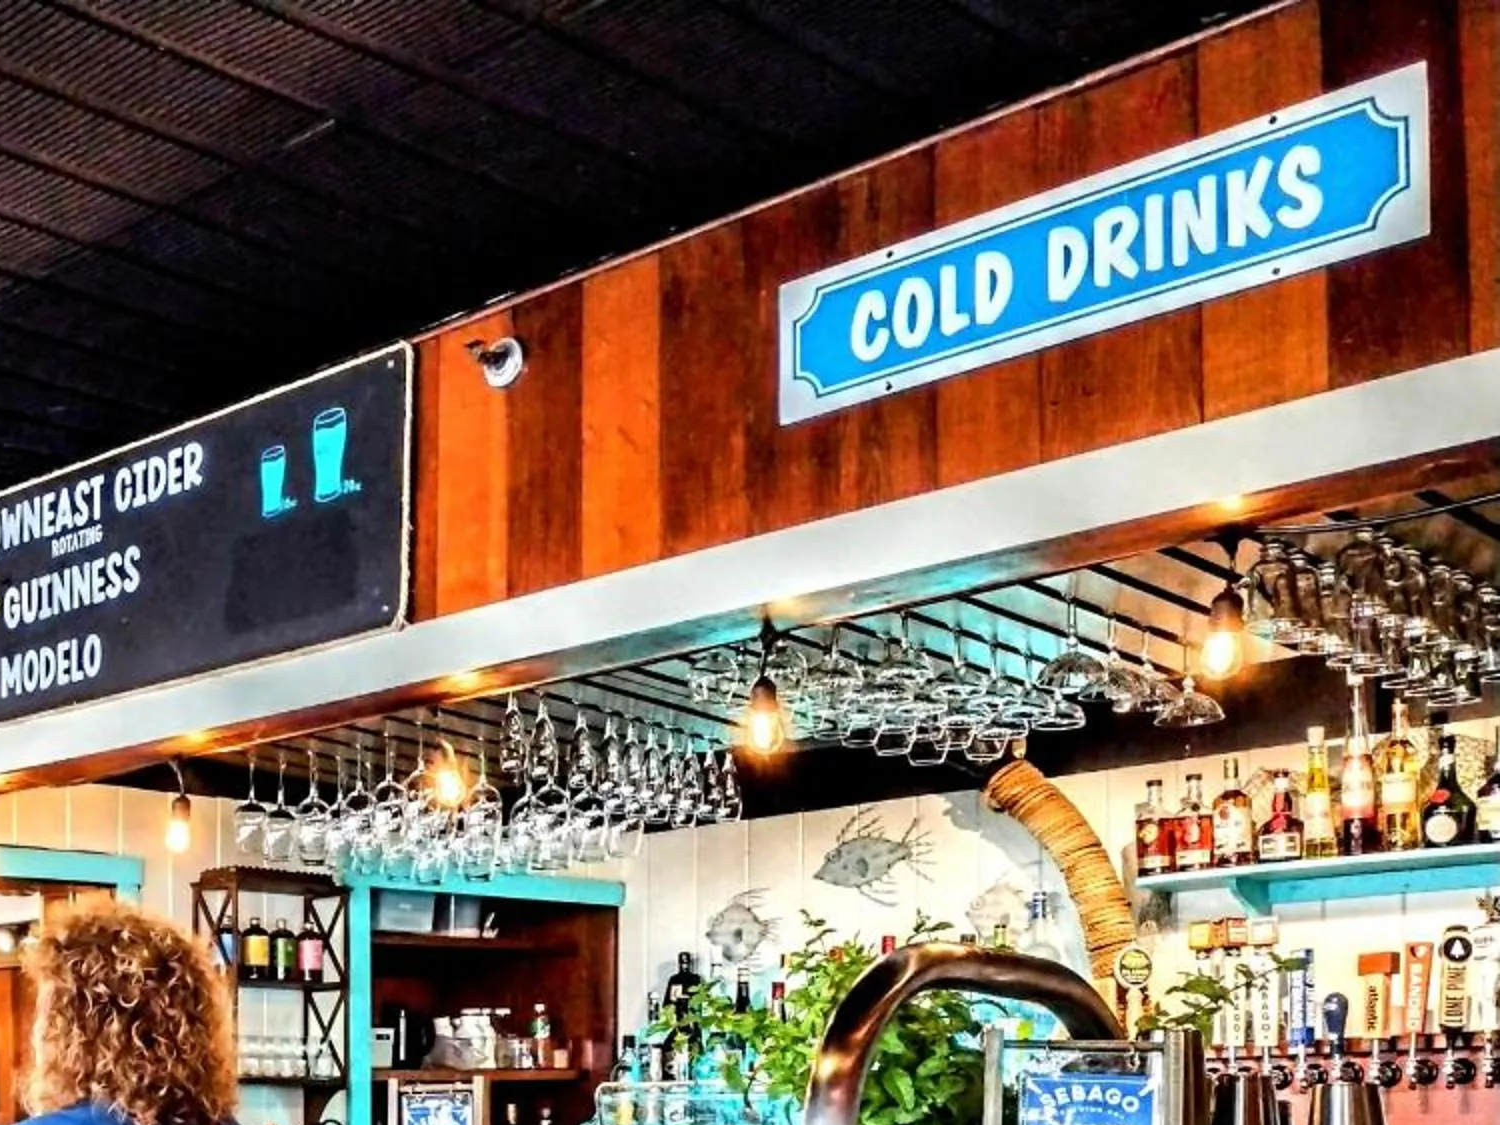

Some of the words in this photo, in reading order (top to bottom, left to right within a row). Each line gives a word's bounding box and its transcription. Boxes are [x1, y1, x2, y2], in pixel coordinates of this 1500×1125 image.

[850, 251, 1013, 363] COLD
[1047, 145, 1324, 303] DRINKS
[113, 441, 204, 515] CIDER
[51, 524, 104, 558] ROTATING
[3, 545, 142, 629] GUINNESS
[0, 633, 103, 699] MODELO
[1444, 995, 1465, 1023] LONE
[1040, 1084, 1140, 1113] SEBAGO
